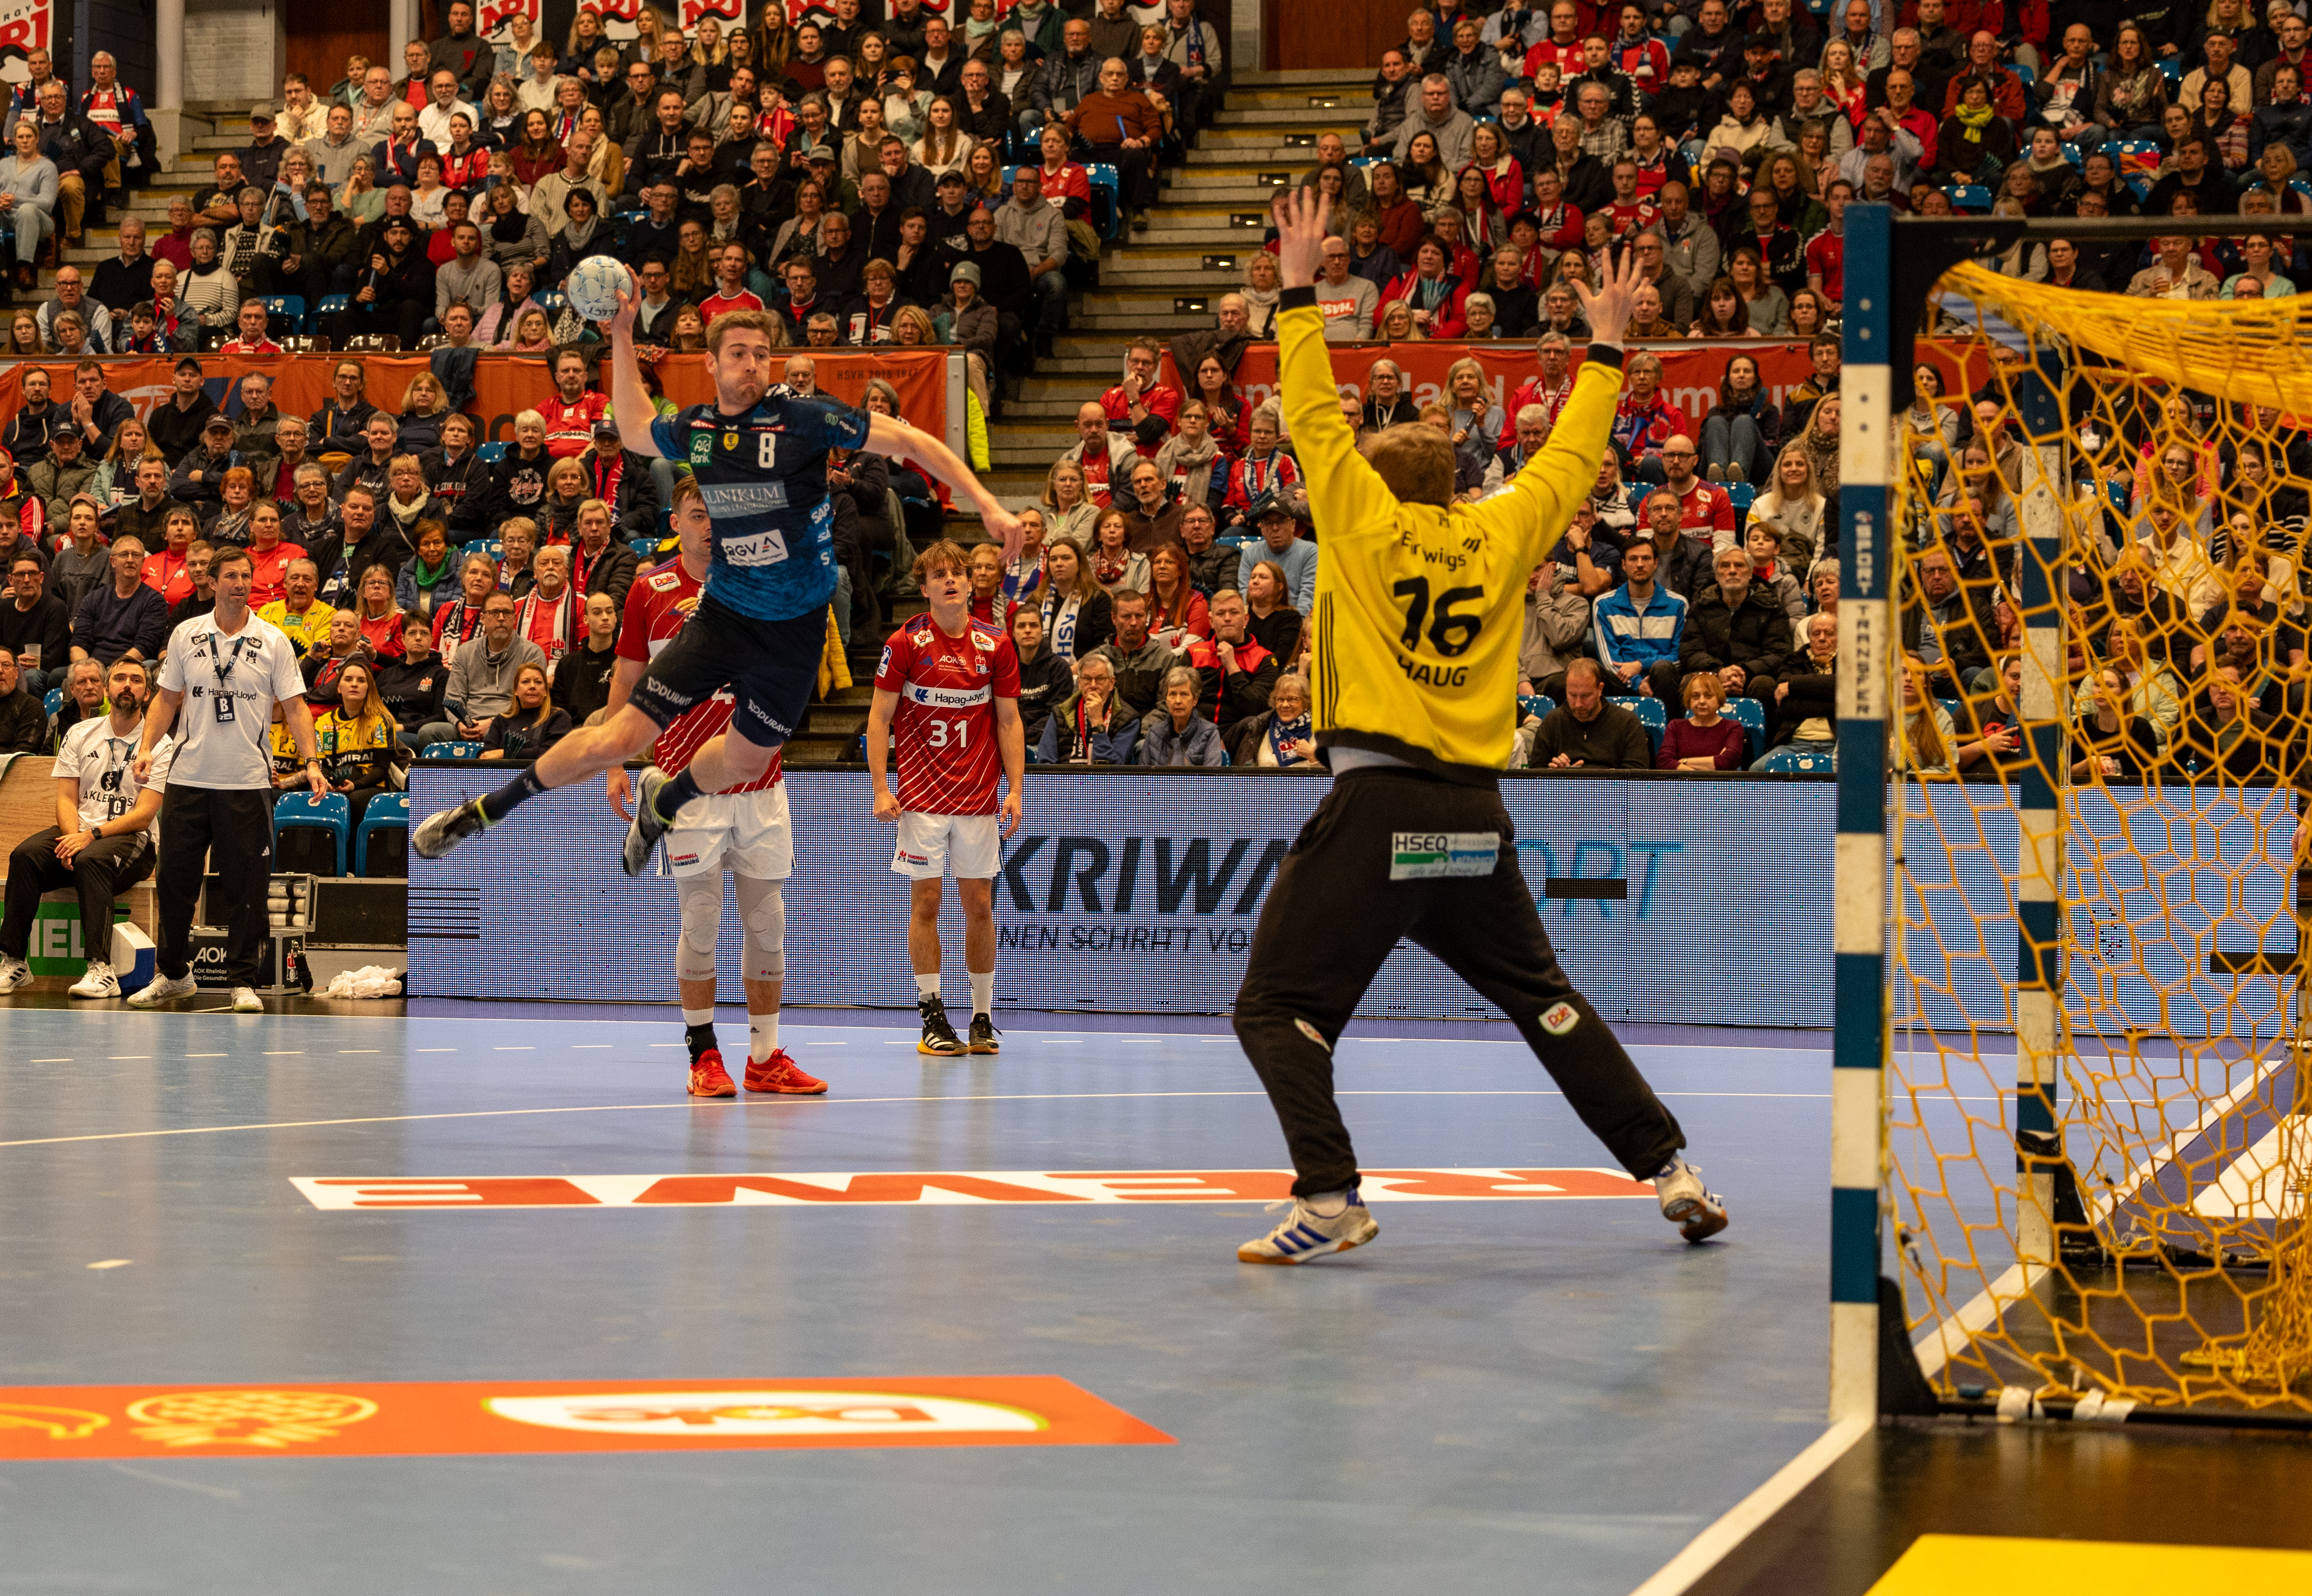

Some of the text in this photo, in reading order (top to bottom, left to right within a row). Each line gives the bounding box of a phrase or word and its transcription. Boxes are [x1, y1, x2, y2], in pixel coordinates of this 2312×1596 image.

[691, 452, 710, 463] Bank
[759, 433, 776, 468] 8
[811, 503, 830, 524] SAP
[653, 575, 675, 586] Dole
[939, 655, 958, 664] AOK
[208, 688, 257, 701] Hapag-Lloyd
[219, 698, 229, 713] B
[929, 719, 967, 747] 31
[114, 802, 121, 814] C
[1395, 836, 1448, 855] HSEQ
[1069, 927, 1197, 952] SCHRITT
[1547, 1005, 1571, 1027] Dole
